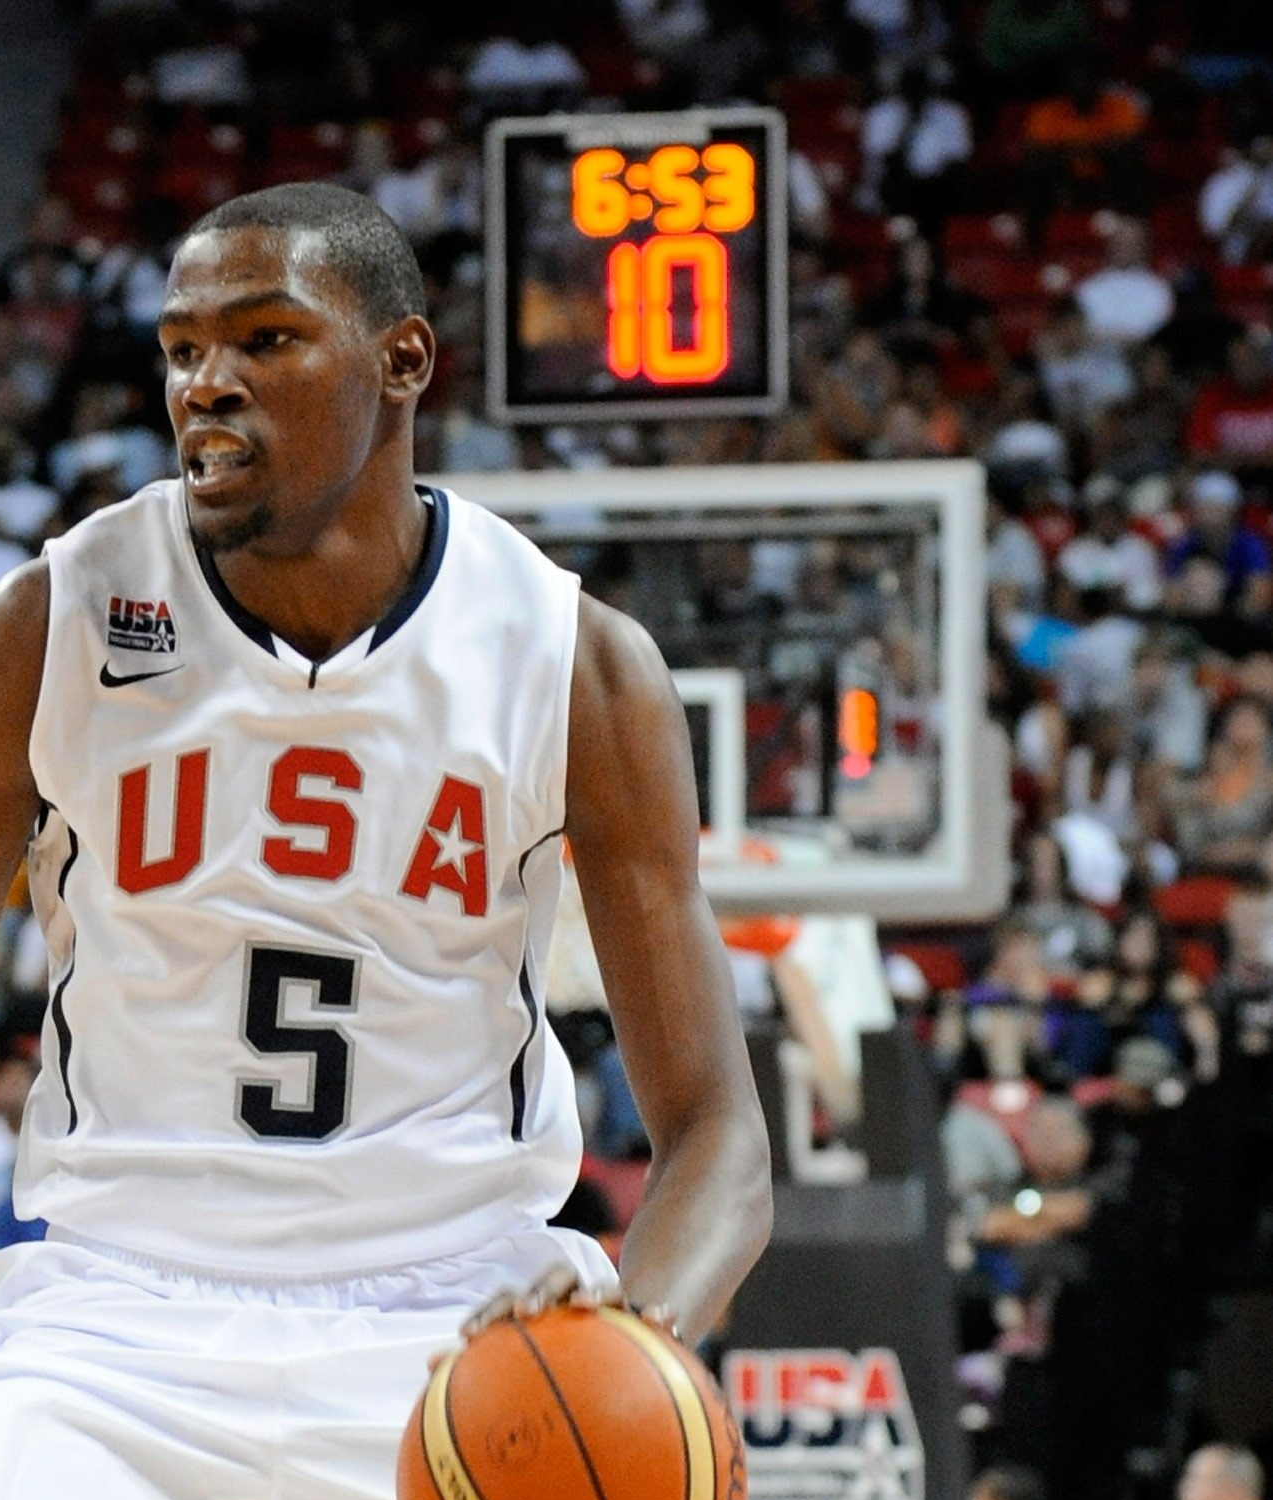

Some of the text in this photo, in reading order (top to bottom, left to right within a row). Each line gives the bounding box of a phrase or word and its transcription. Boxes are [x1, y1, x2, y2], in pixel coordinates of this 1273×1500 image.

[572, 143, 755, 237] 6:53
[608, 233, 729, 384] 10
[108, 596, 175, 636] USA
[114, 745, 490, 917] USA
[234, 940, 363, 1145] 5
[739, 1361, 901, 1448] USA
